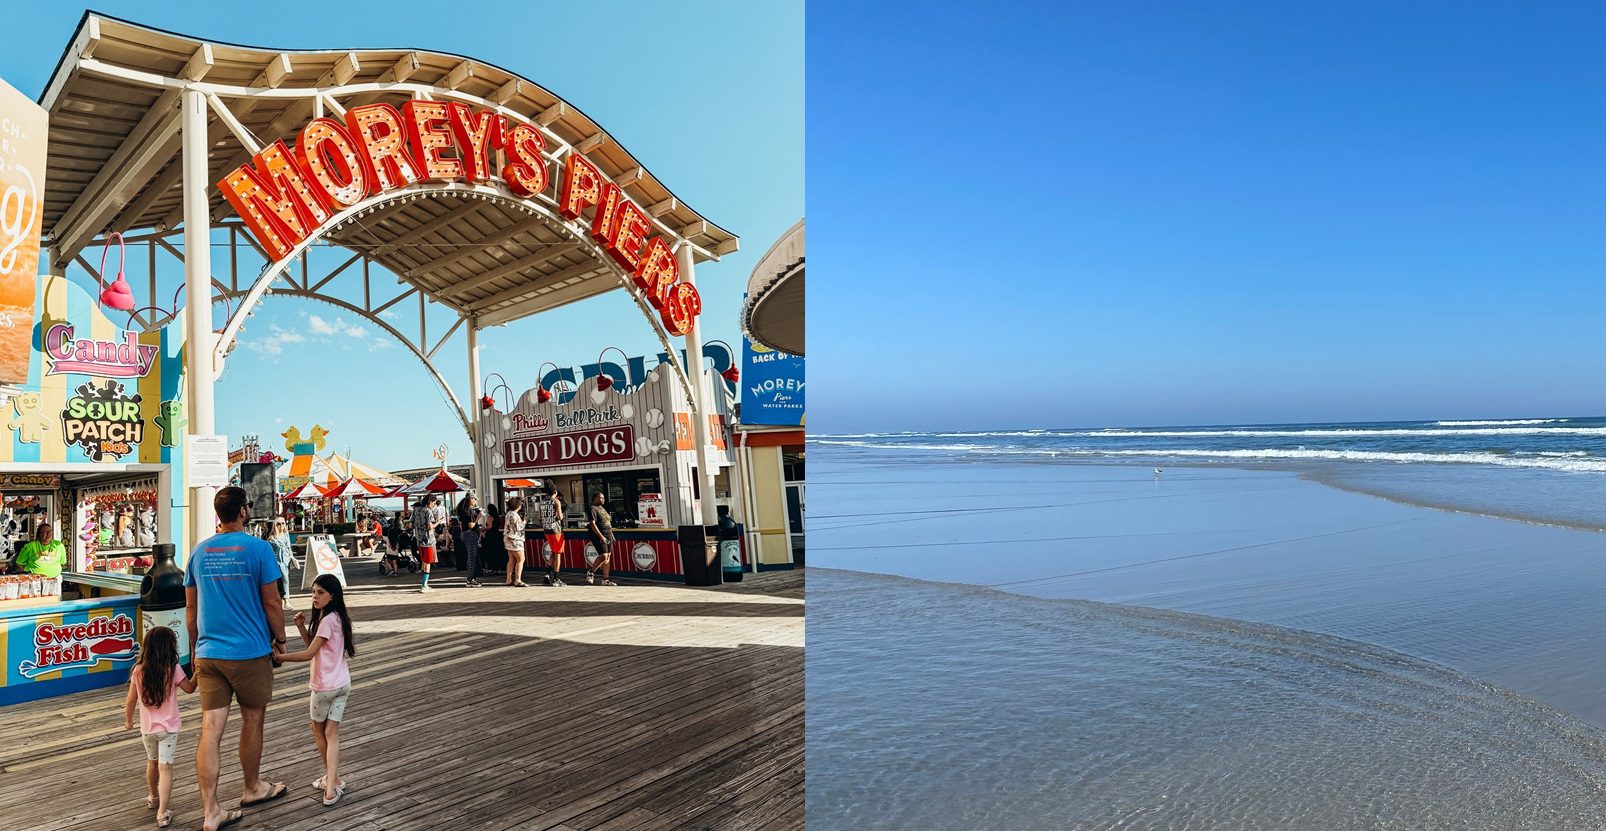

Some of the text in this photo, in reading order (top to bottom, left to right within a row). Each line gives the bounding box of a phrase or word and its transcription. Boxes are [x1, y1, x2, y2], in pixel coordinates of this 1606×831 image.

[216, 99, 702, 337] MOREY'S PIERS
[47, 324, 158, 375] Candy
[752, 352, 775, 364] BACK
[69, 397, 139, 423] SOUR
[512, 405, 620, 435] Philly Ball Park
[66, 419, 141, 443] PATCH
[101, 440, 129, 453] Kids
[509, 430, 627, 464] HOT DOGS
[11, 475, 53, 485] CANDY
[37, 615, 133, 645] Swedish
[37, 642, 88, 667] Fish
